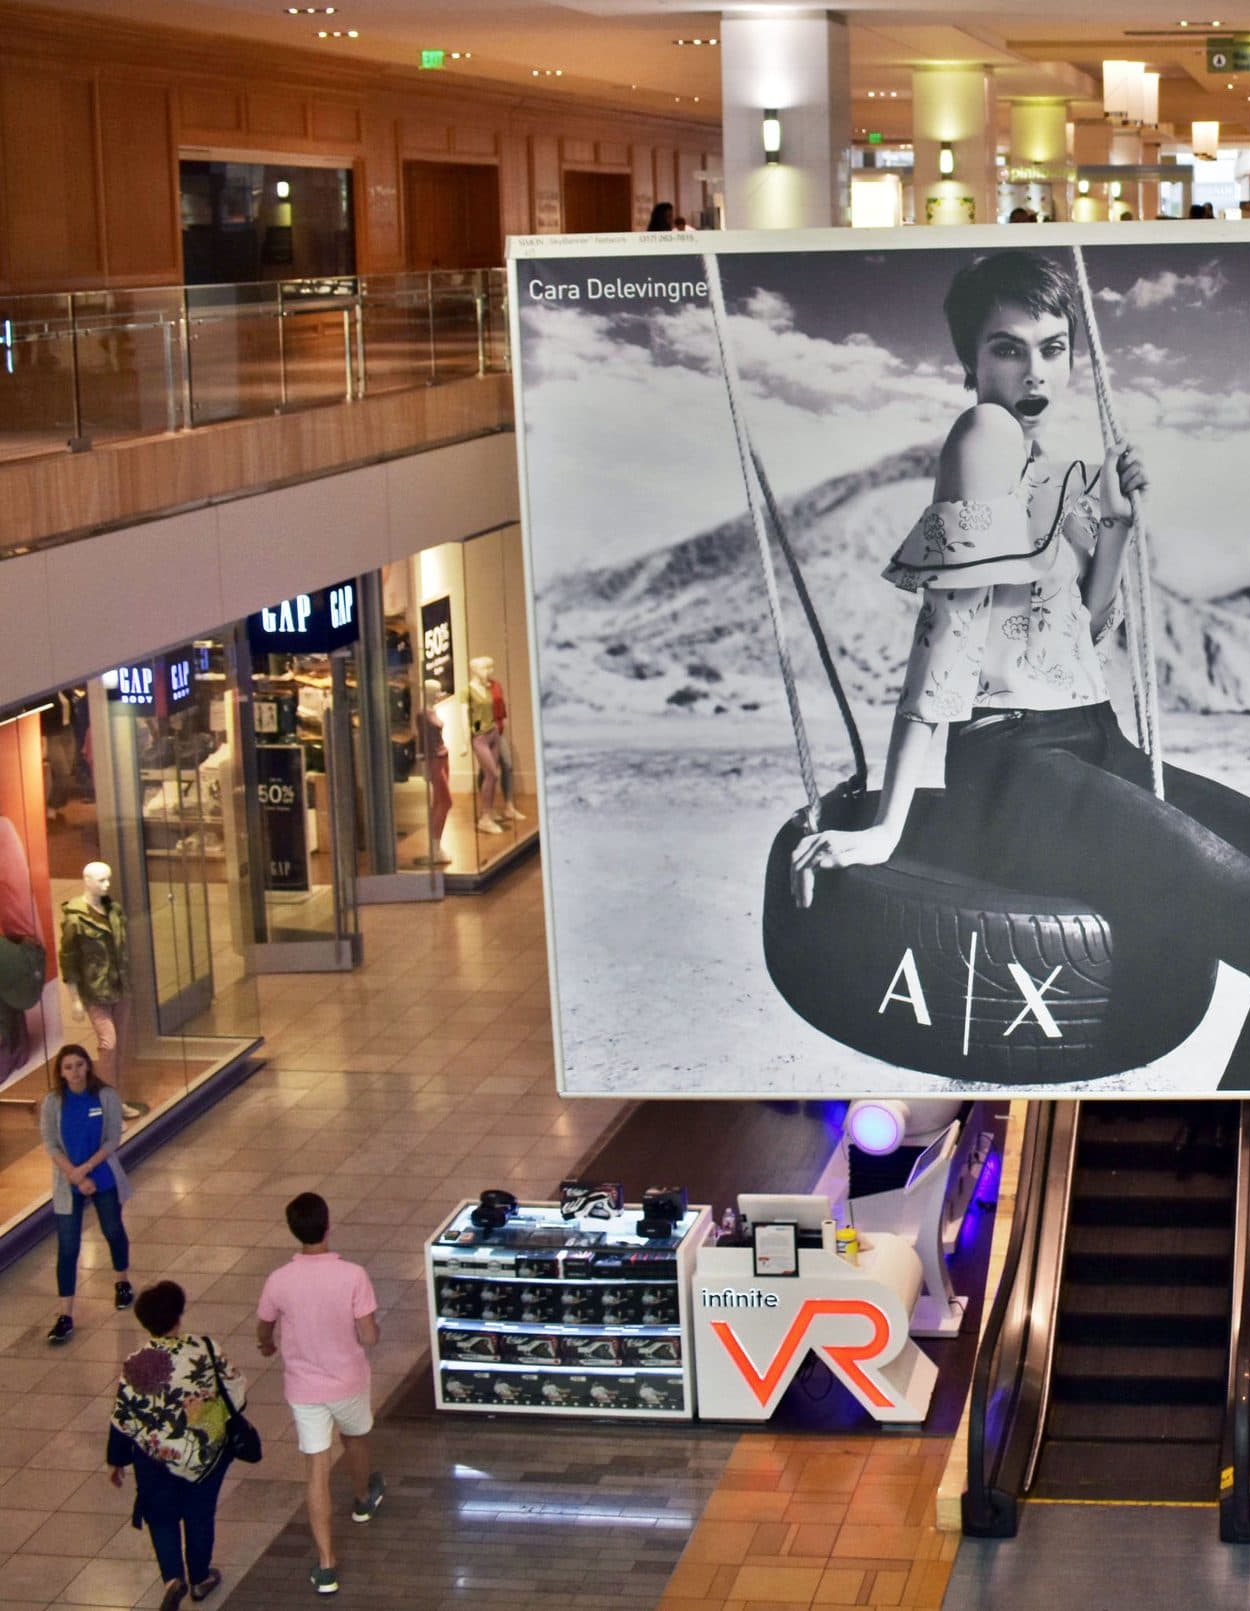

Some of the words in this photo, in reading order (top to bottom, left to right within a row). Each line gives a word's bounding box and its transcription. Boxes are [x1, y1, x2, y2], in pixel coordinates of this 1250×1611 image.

[529, 279, 580, 300] Cara
[587, 277, 707, 303] Delevingne
[262, 594, 311, 632] GAP
[330, 585, 353, 629] GAP
[119, 667, 153, 694] GAP
[171, 661, 189, 691] GAP
[121, 695, 153, 704] BODY
[702, 1290, 778, 1308] infinite
[710, 1300, 895, 1408] VR
